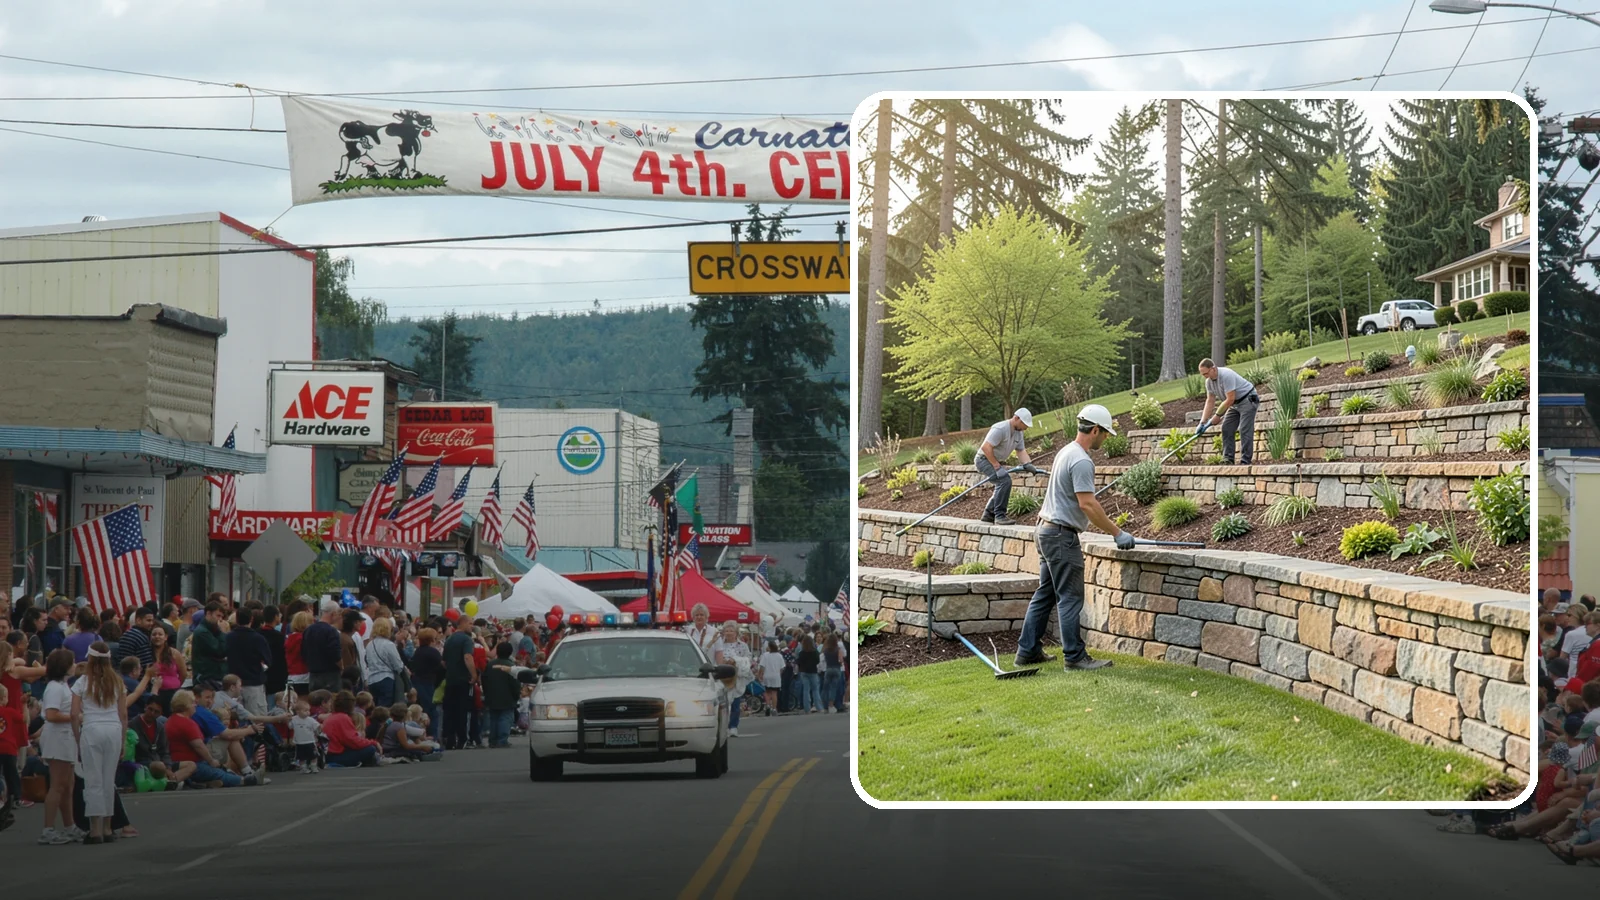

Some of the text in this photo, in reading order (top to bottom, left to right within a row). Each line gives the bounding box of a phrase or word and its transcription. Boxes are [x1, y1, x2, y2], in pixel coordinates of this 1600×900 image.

[695, 121, 850, 149] Carnat
[481, 141, 605, 192] JULY
[632, 150, 746, 197] 4th.
[697, 254, 850, 280] CROSSWA
[283, 380, 373, 420] ACE
[405, 409, 452, 422] CEDAR
[283, 421, 371, 437] Hardware
[416, 428, 477, 447] Coca-Cola
[353, 467, 387, 480] Simpl
[83, 484, 155, 496] St. Vincent de Paul
[81, 502, 154, 522] THT
[212, 515, 330, 537] HARDARE
[688, 526, 741, 535] CRNATION
[699, 535, 730, 544] GLASS
